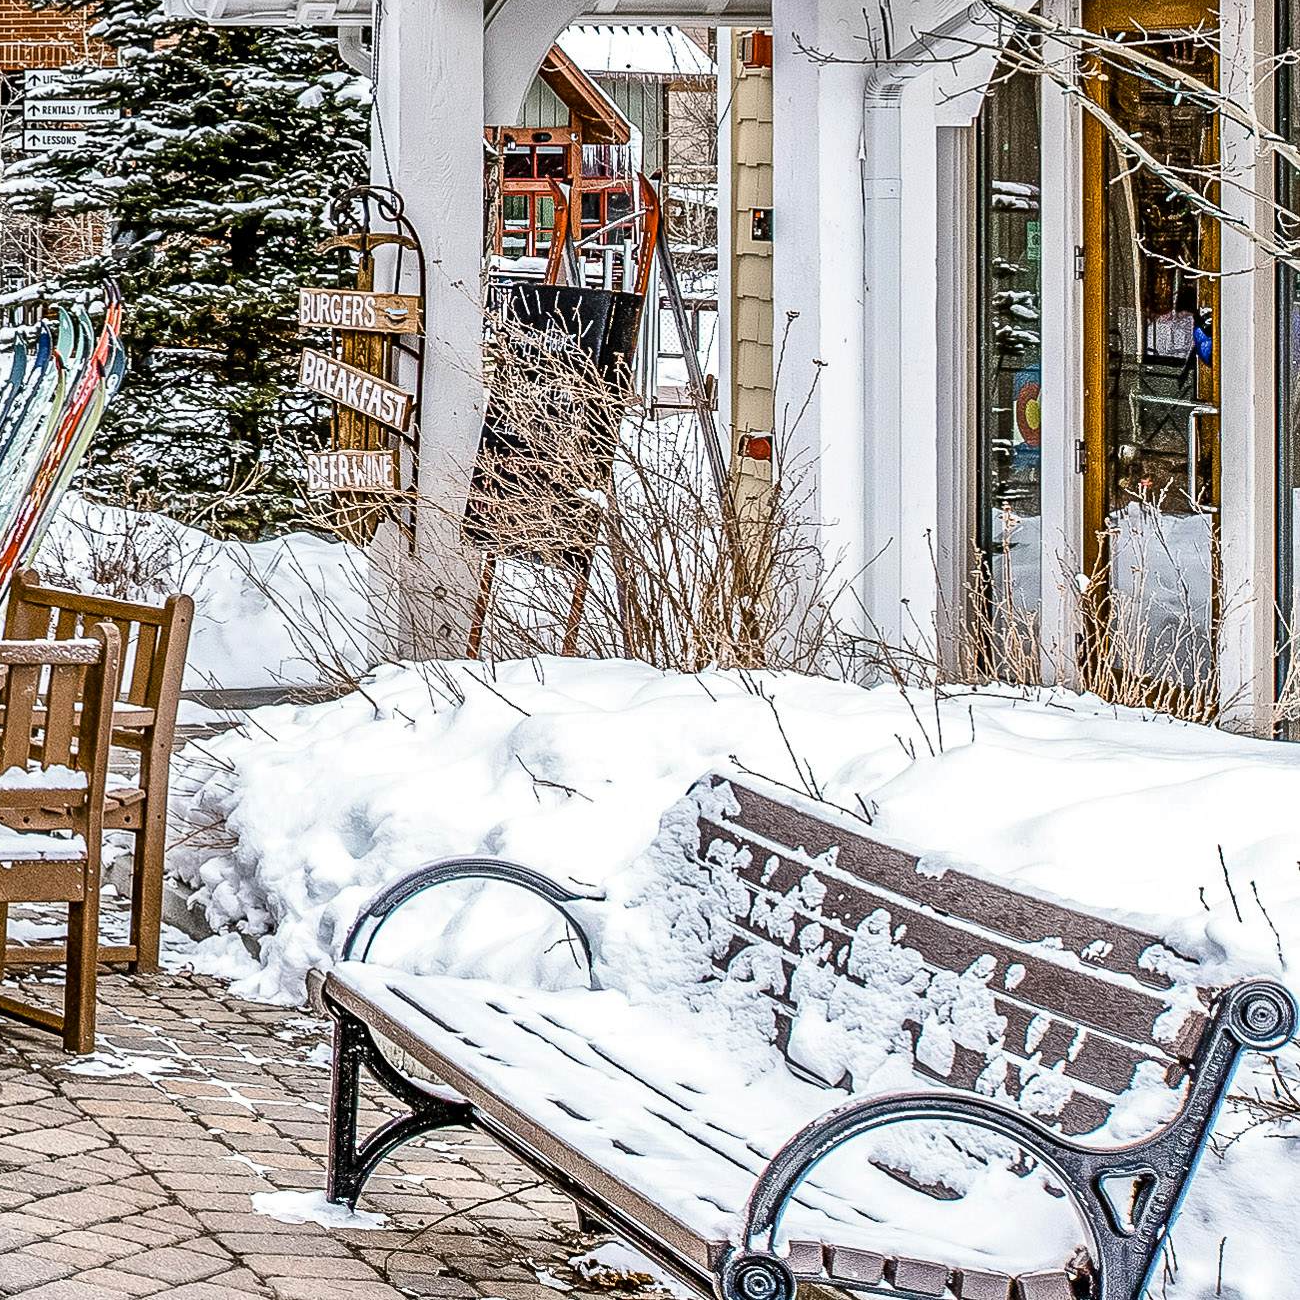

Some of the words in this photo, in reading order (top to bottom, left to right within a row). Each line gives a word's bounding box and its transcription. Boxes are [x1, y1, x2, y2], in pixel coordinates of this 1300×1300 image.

[42, 105, 76, 115] RENTALS
[42, 135, 78, 145] LESSONS
[300, 291, 377, 328] BURGERS
[302, 350, 408, 428] BREAKFAST
